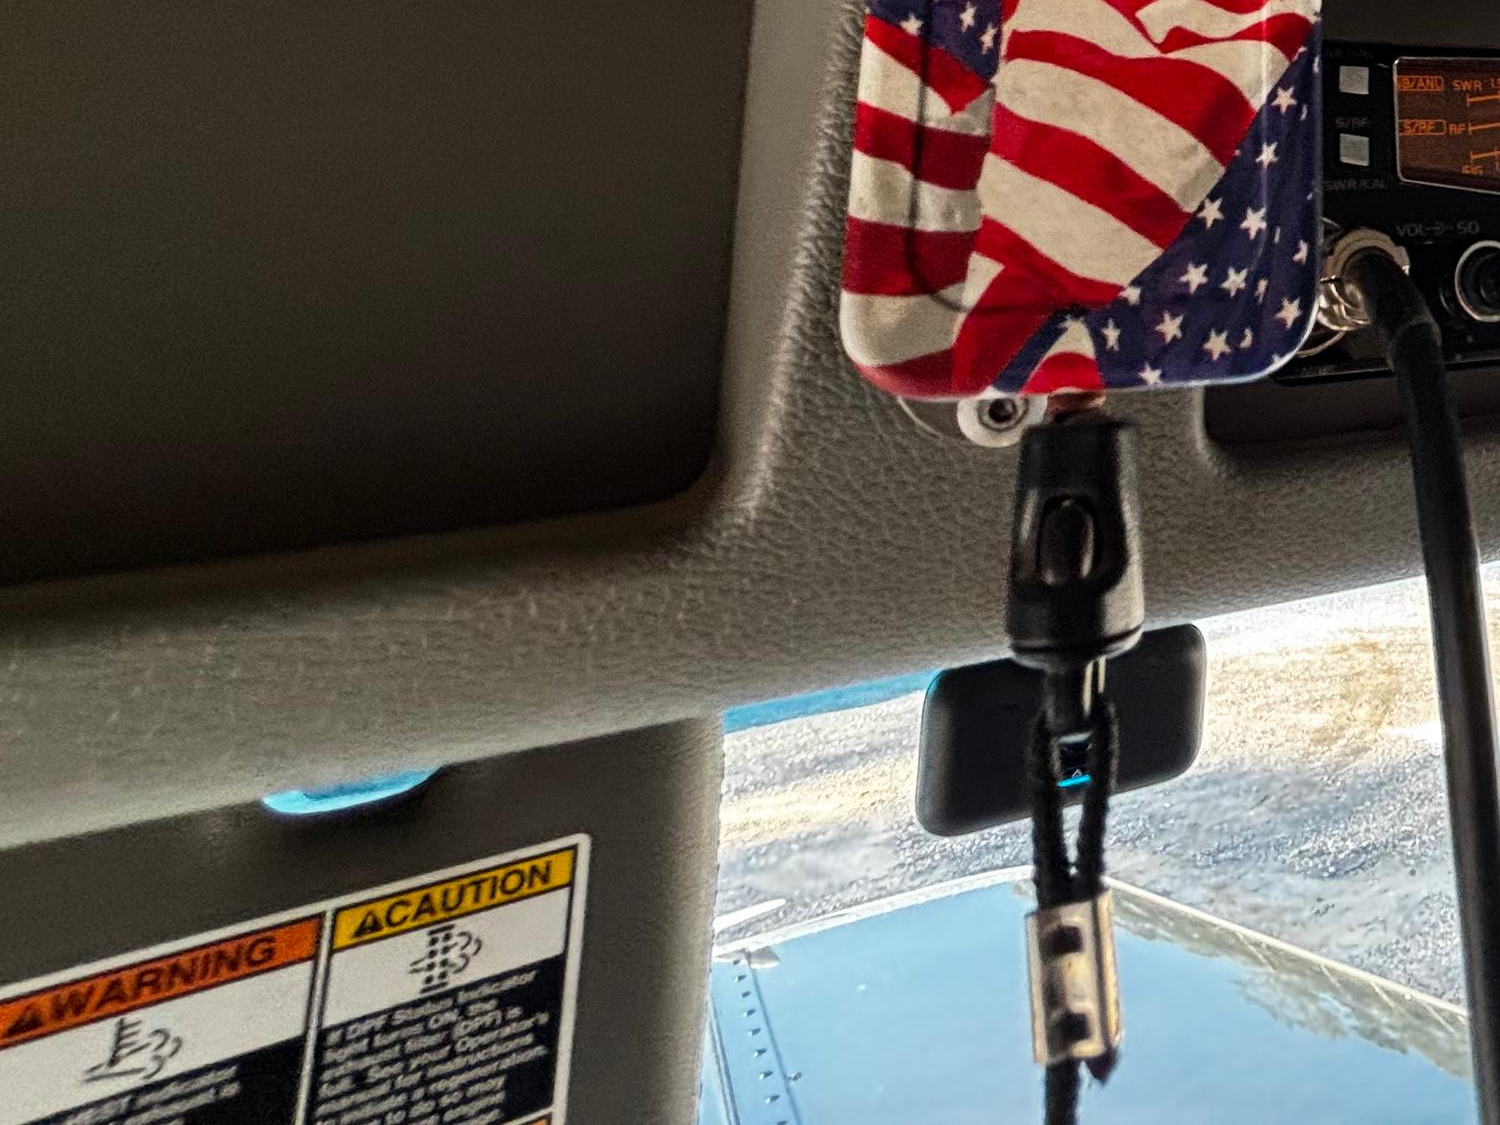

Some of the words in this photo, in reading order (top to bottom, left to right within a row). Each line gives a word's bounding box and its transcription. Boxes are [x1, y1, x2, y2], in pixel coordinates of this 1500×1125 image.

[1452, 80, 1483, 92] SWR
[1449, 124, 1466, 136] RF
[1396, 222, 1426, 237] VOL
[385, 860, 552, 927] CAUTION
[51, 936, 276, 1016] WARNING
